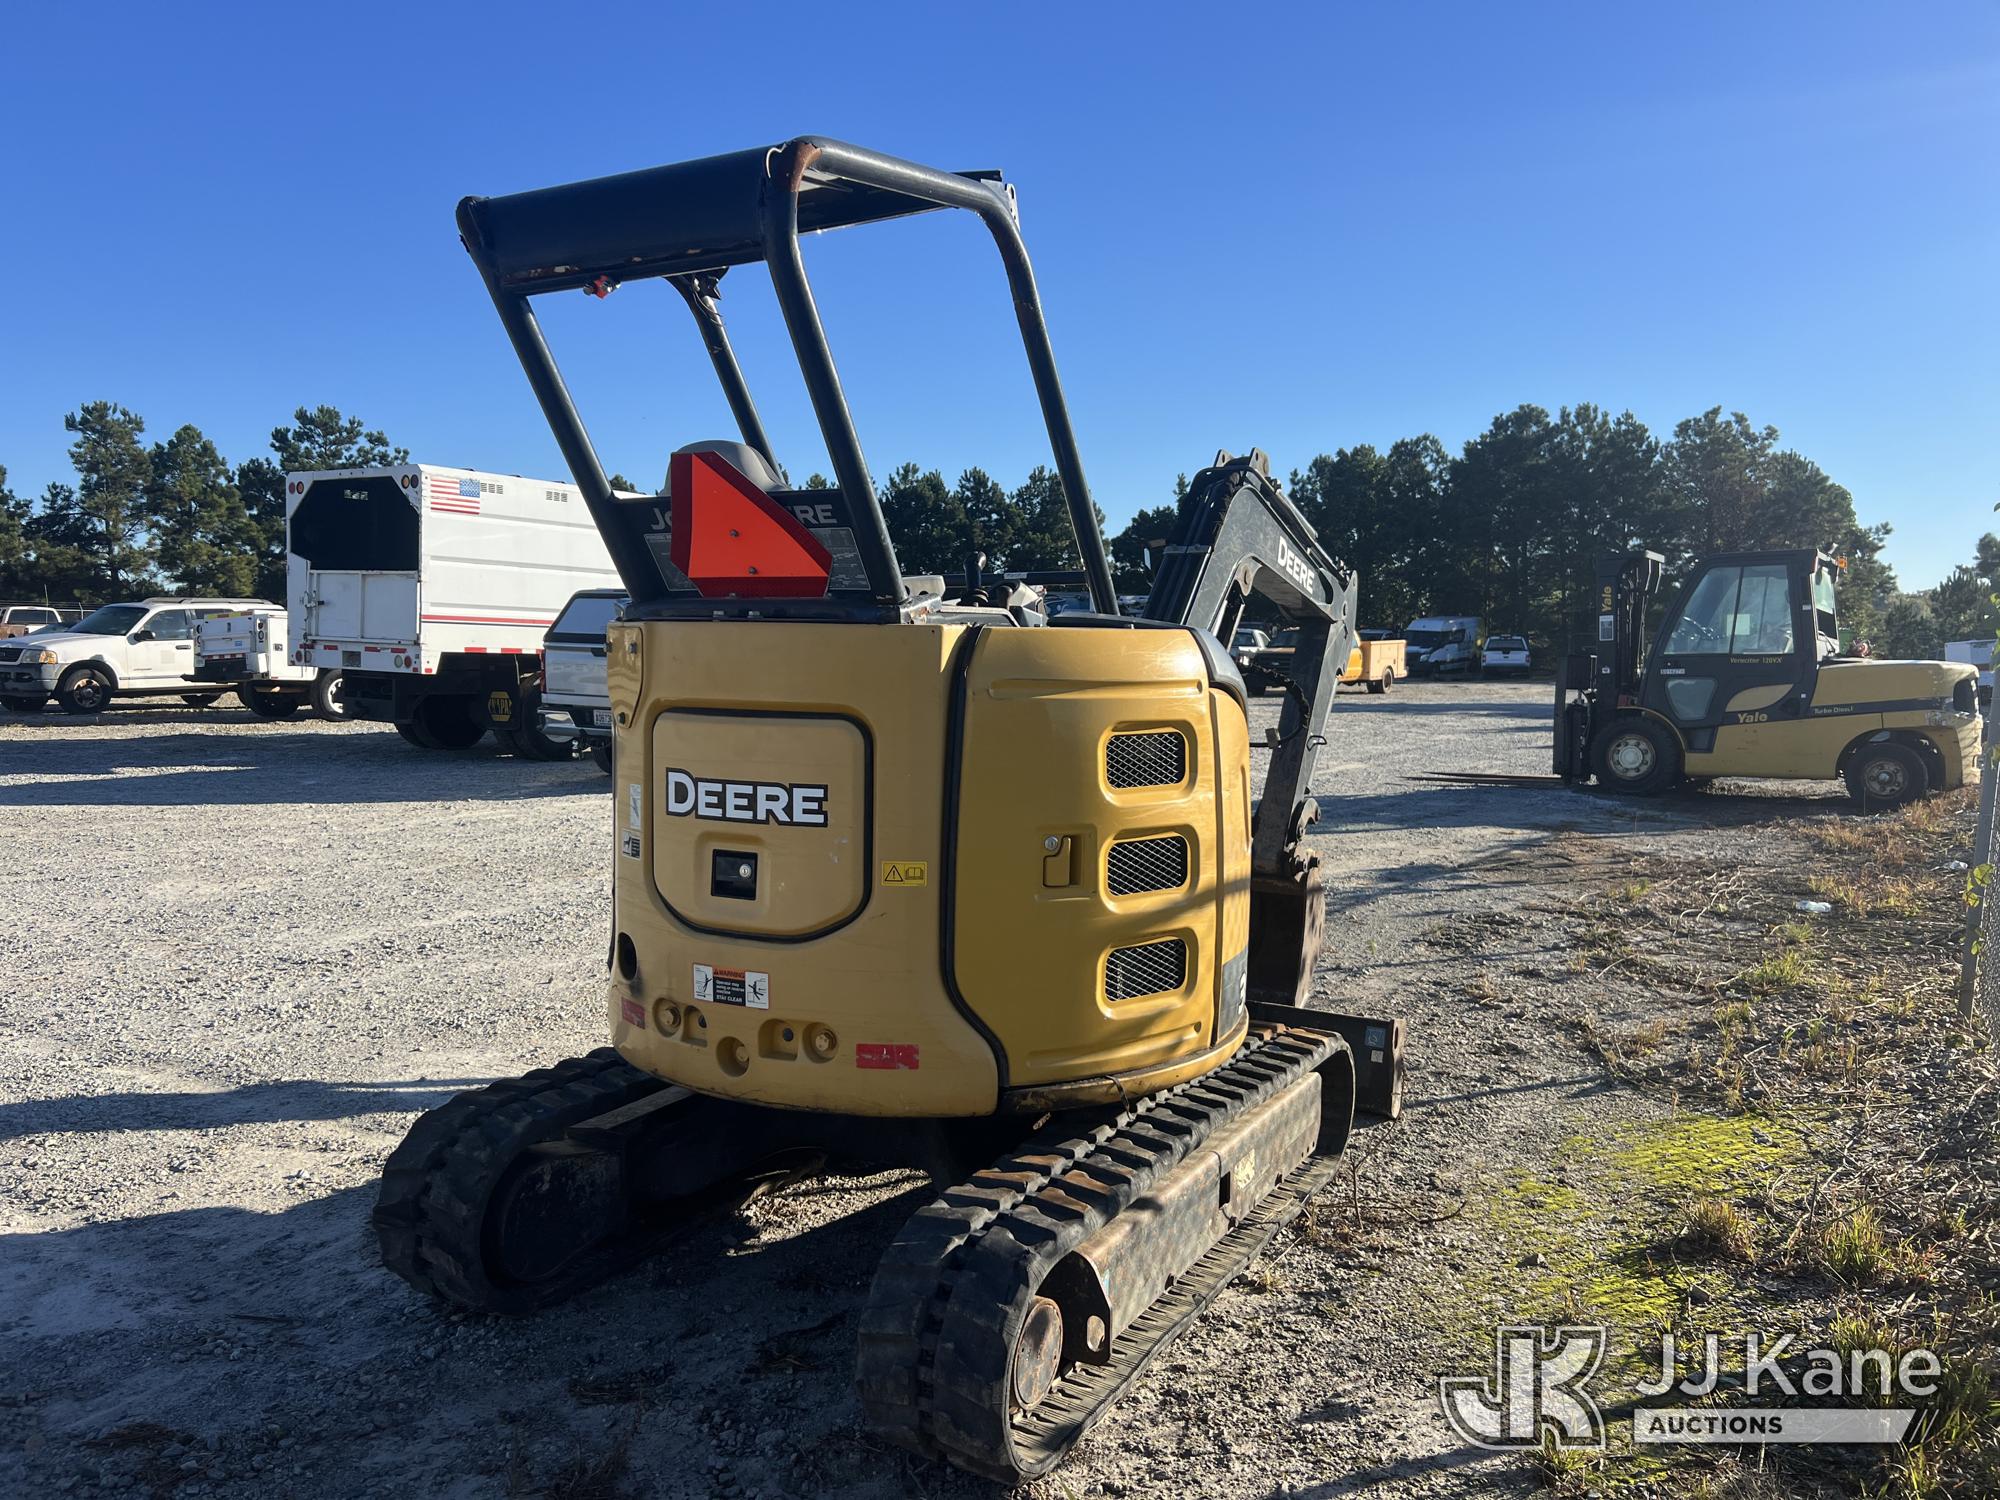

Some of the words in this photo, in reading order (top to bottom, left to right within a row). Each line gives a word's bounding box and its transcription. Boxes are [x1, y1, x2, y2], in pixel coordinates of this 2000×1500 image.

[1278, 535, 1315, 595] DEERE
[1601, 586, 1612, 612] Yale
[1738, 711, 1768, 723] Yale
[667, 768, 827, 826] DEERE
